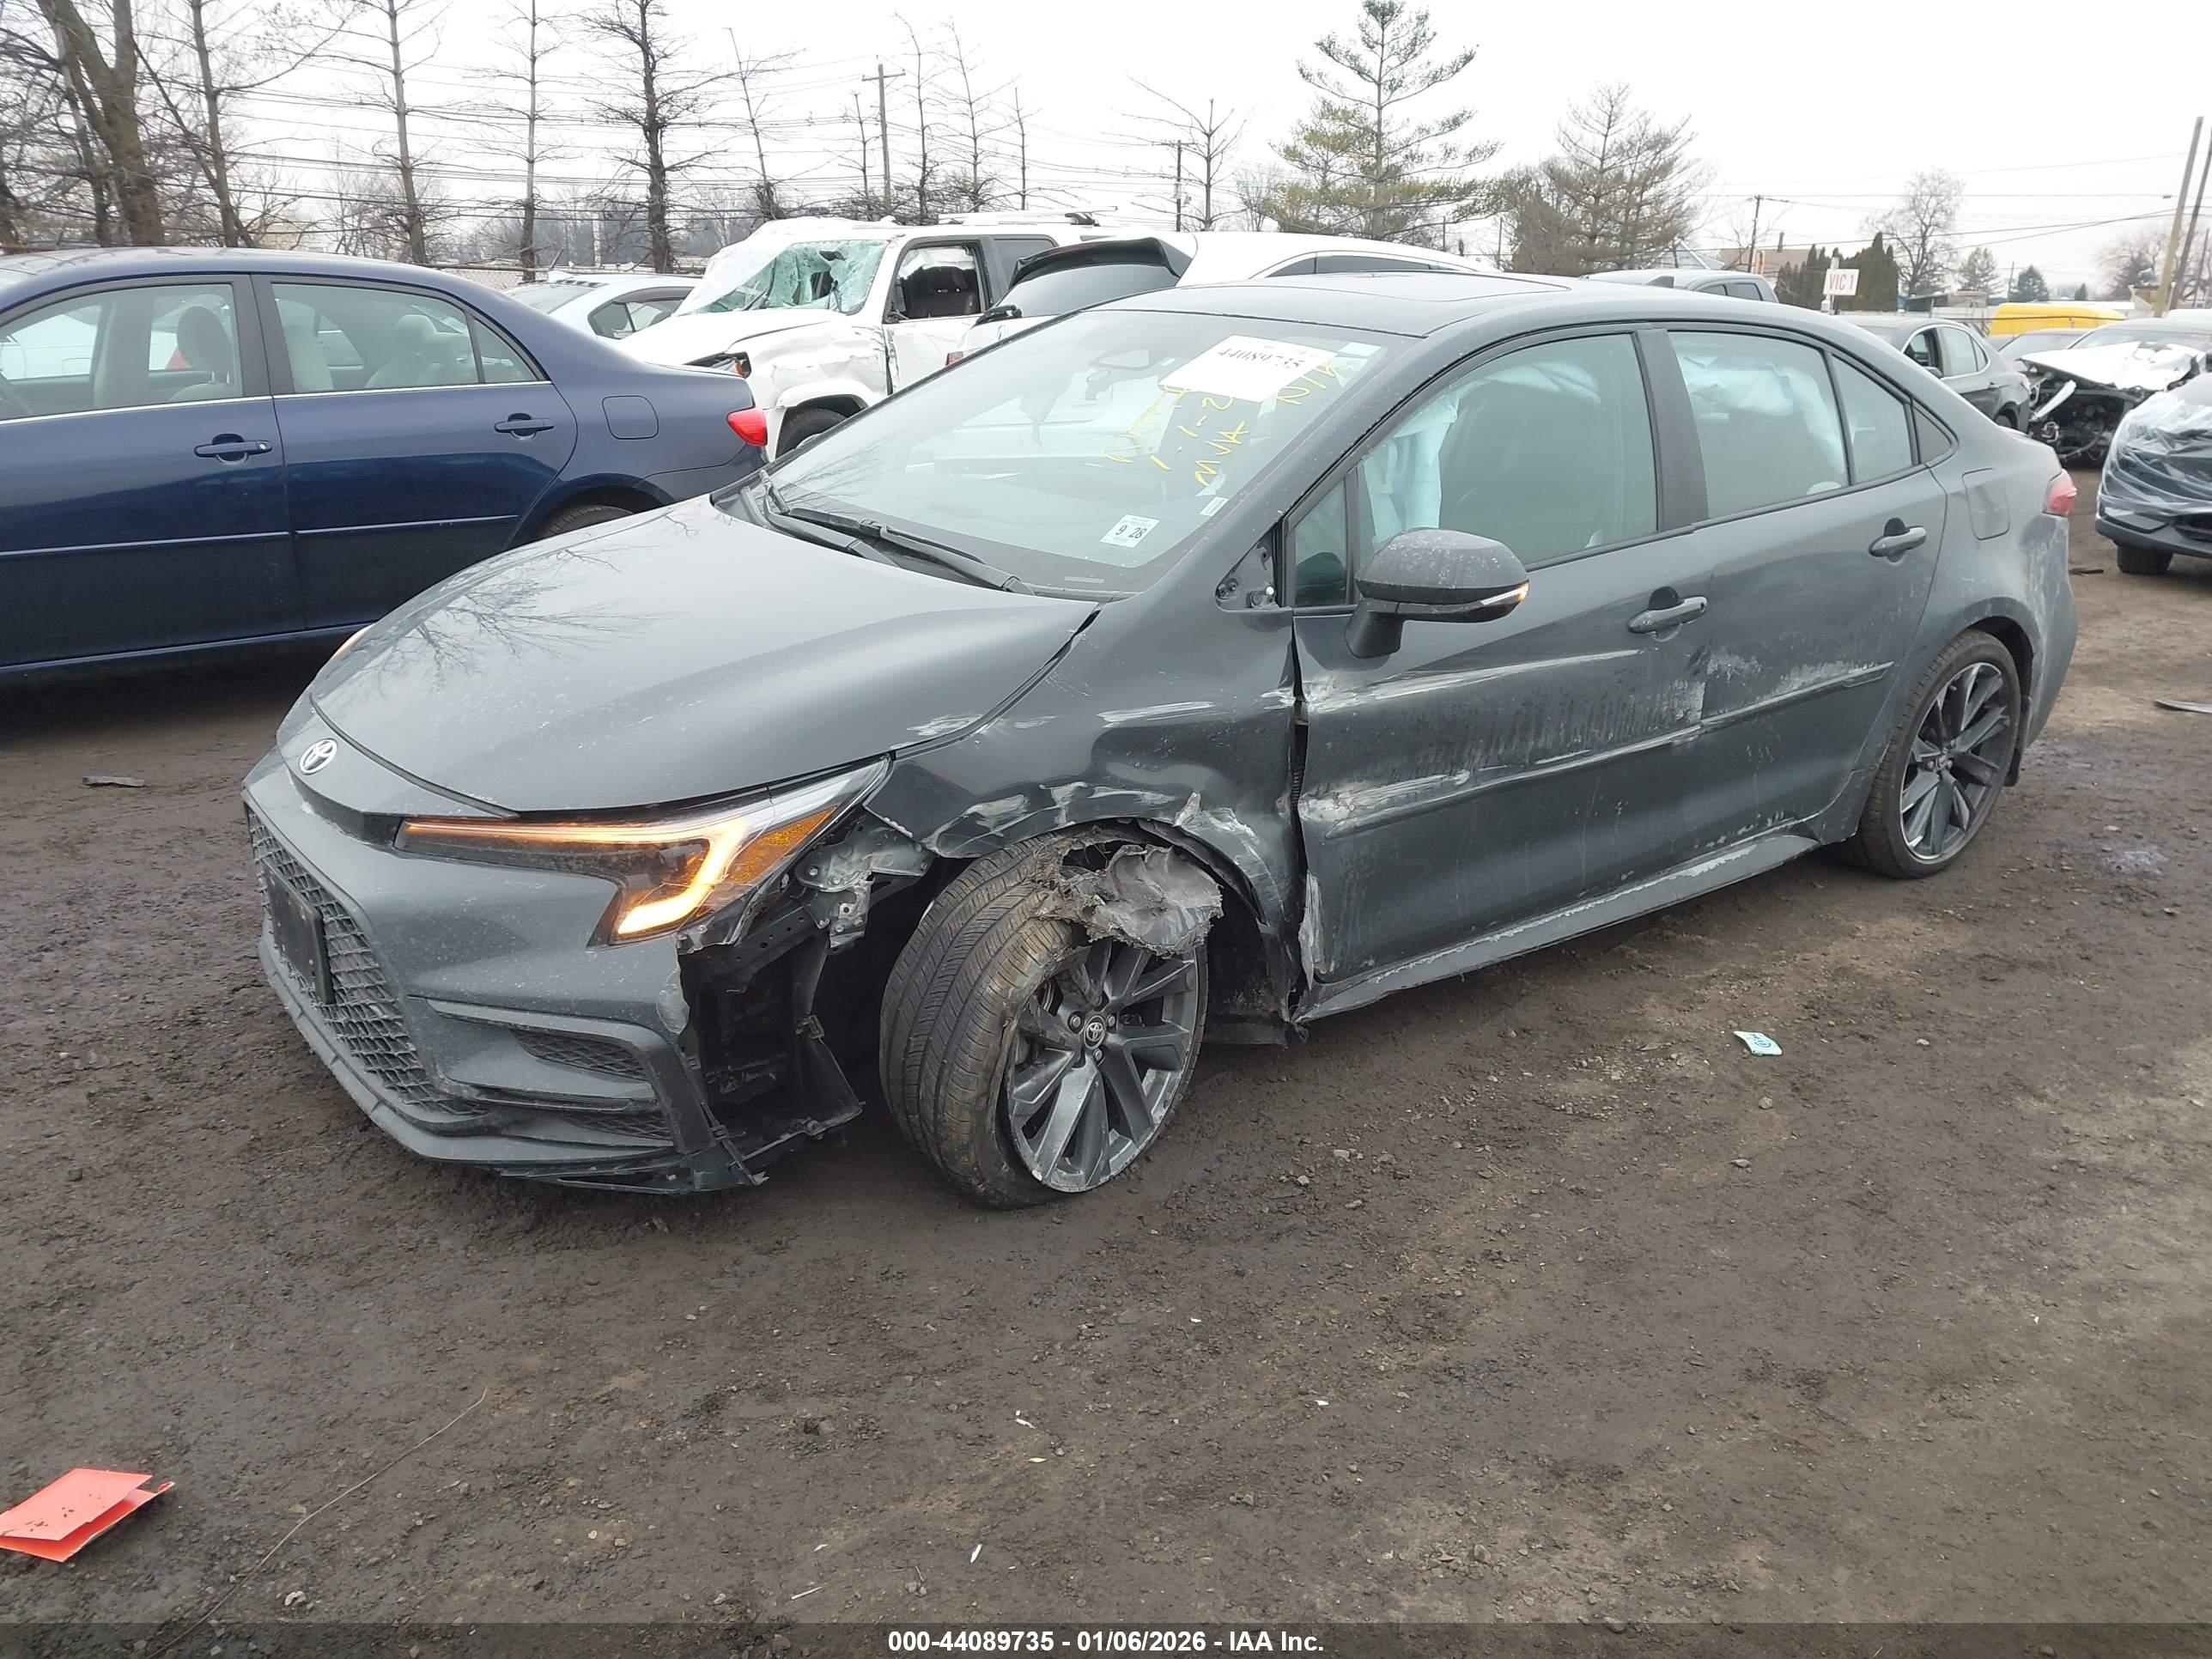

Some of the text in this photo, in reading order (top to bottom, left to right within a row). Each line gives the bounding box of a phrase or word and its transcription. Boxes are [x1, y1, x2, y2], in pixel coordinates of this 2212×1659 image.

[1829, 273, 1847, 290] VIC
[1115, 524, 1148, 539] 9 28
